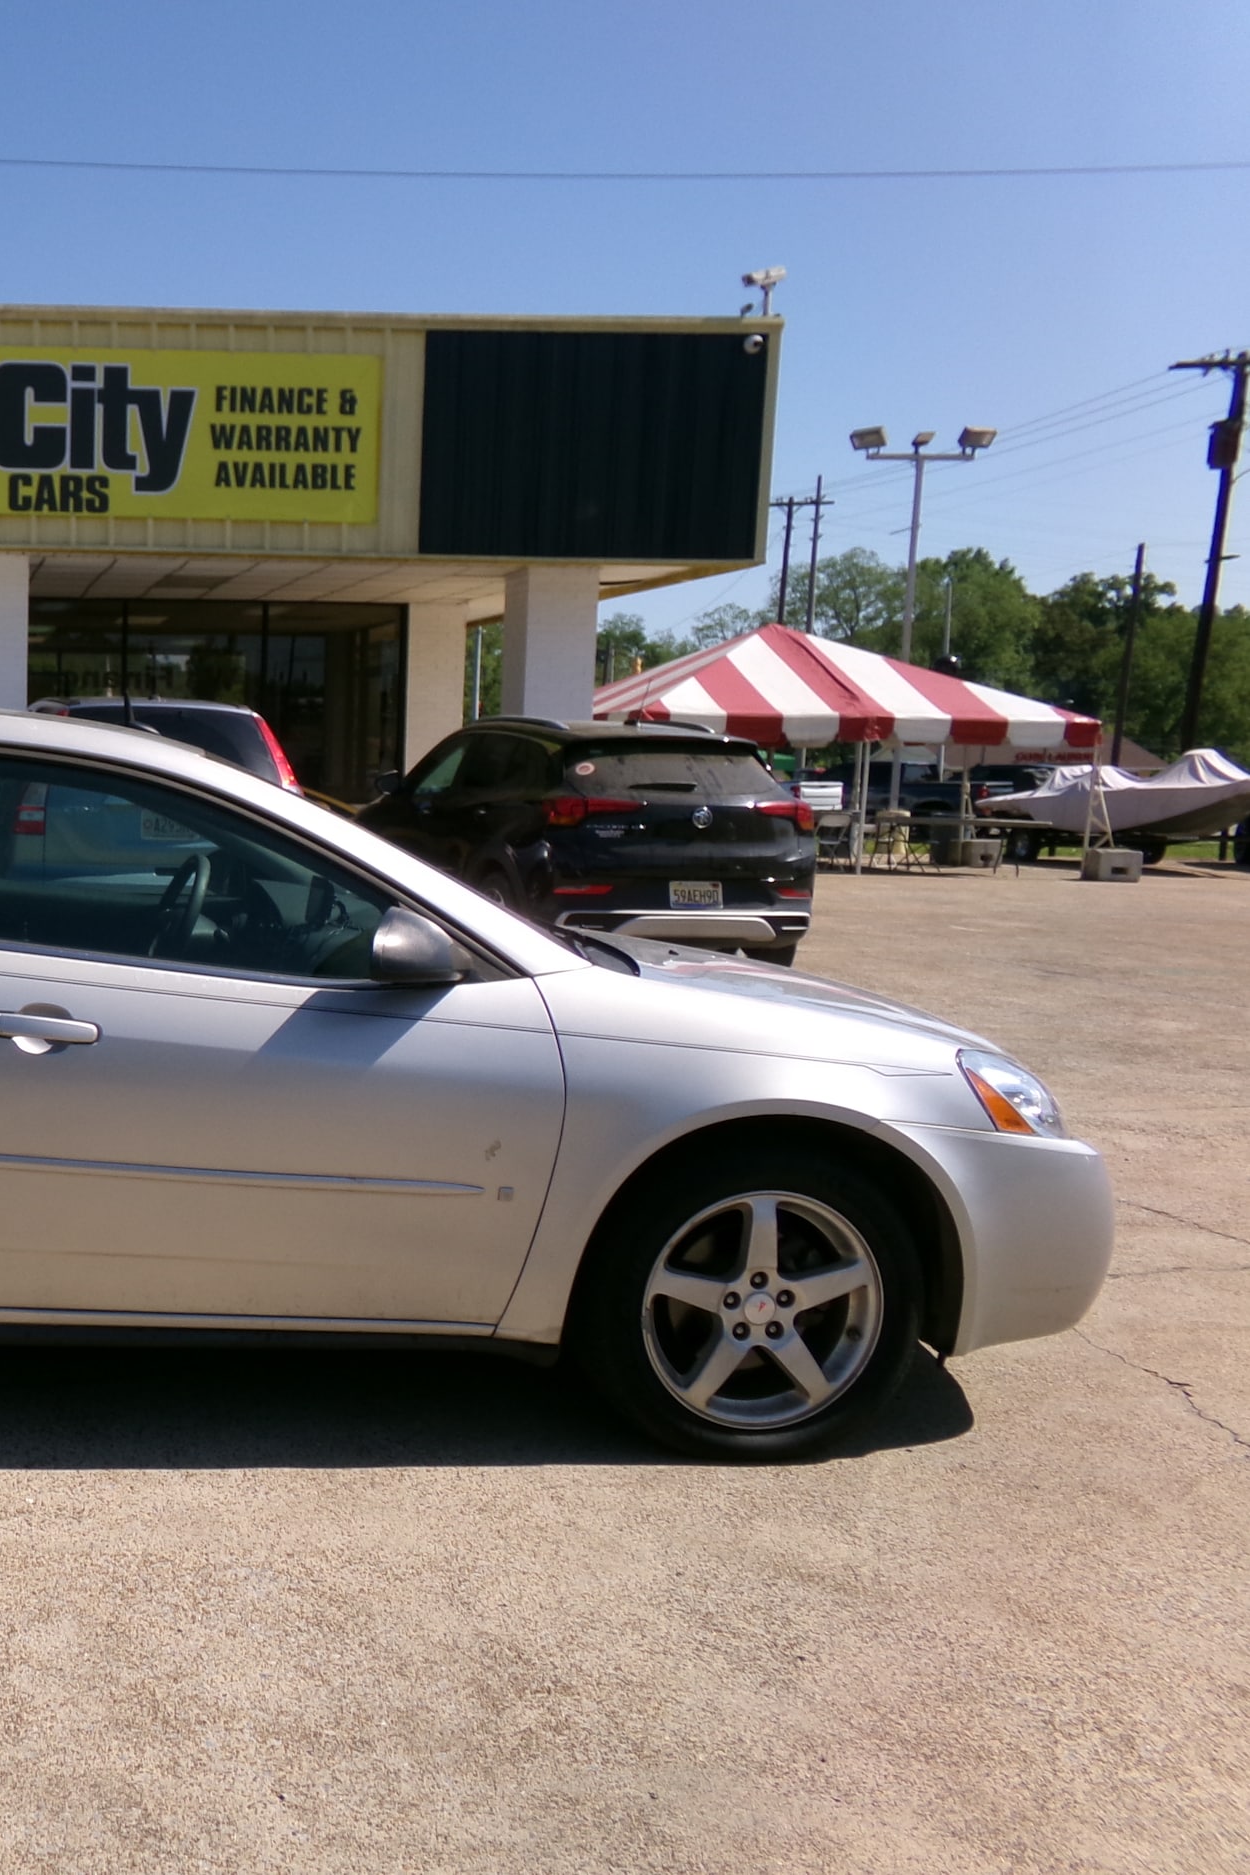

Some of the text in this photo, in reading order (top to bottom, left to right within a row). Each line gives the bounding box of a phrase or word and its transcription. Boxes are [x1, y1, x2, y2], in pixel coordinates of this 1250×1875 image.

[214, 385, 358, 416] FINANCE &
[210, 424, 362, 453] WARRANTY
[214, 461, 356, 490] AVAILABLE
[7, 474, 111, 514] CARS
